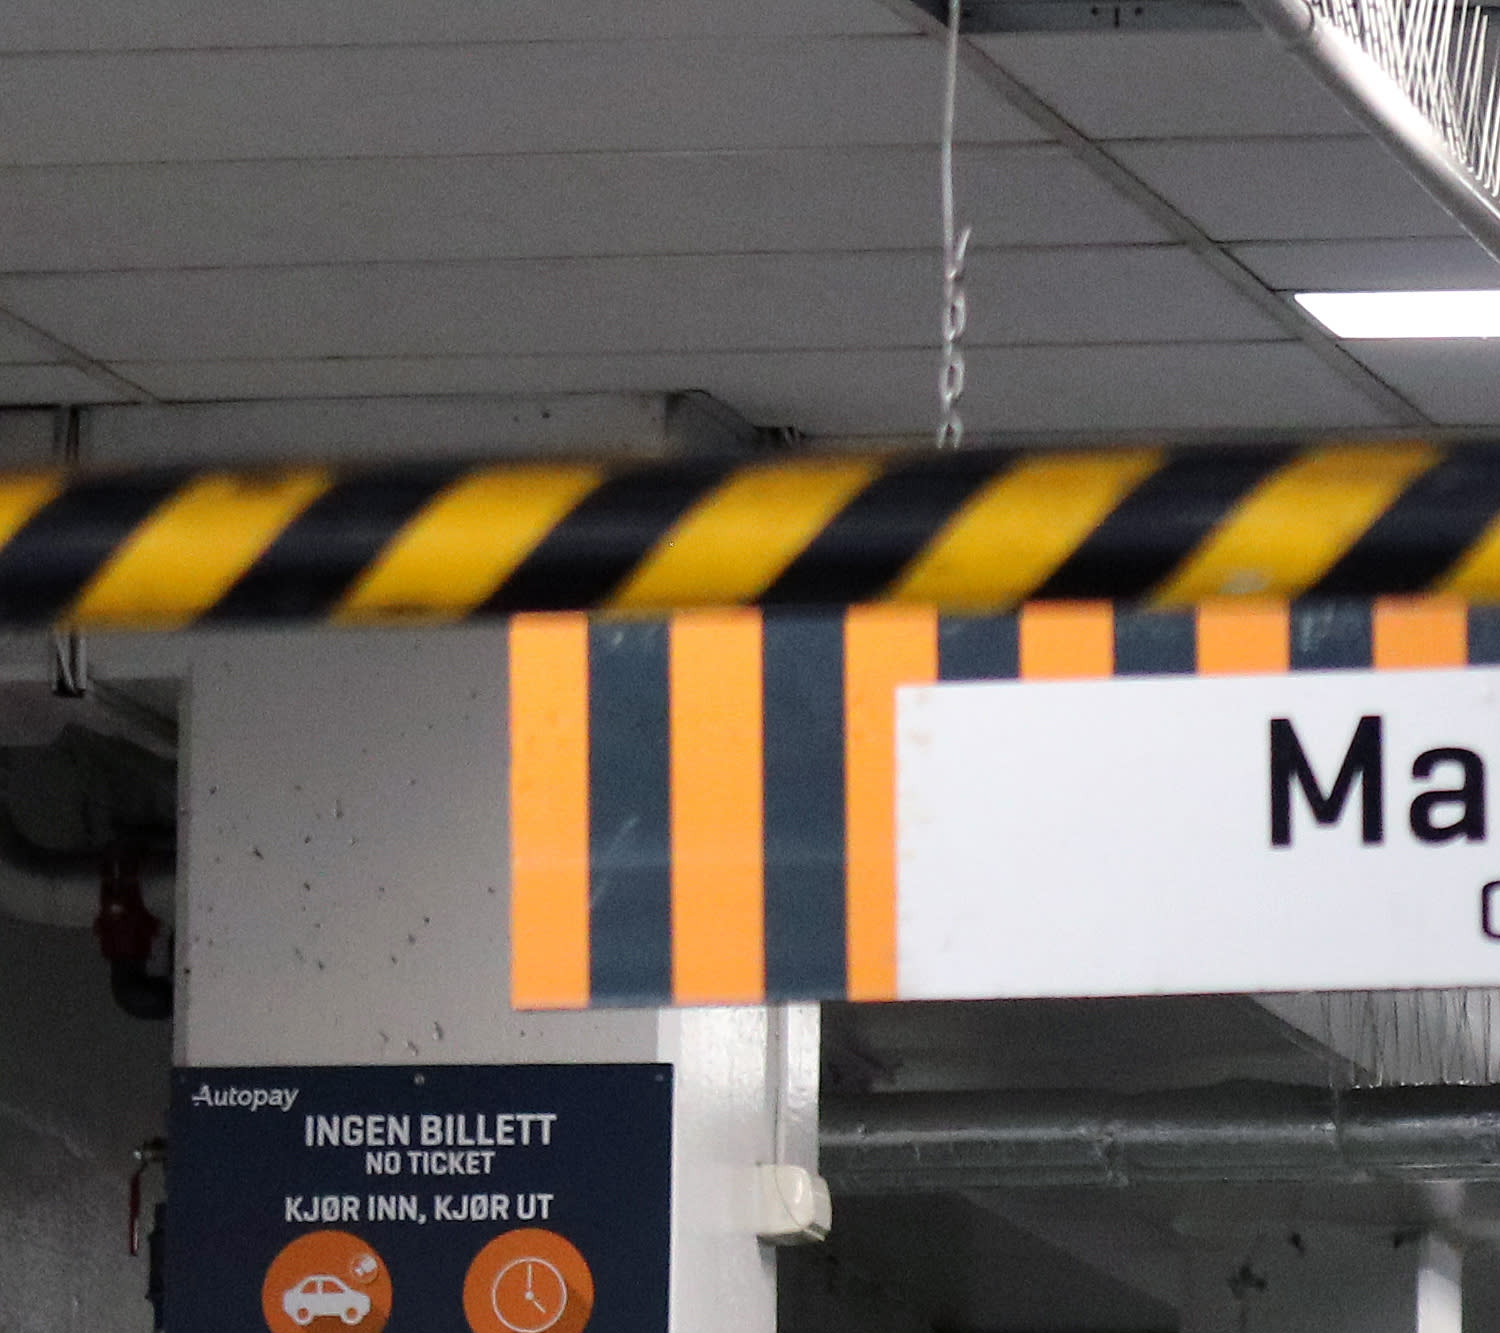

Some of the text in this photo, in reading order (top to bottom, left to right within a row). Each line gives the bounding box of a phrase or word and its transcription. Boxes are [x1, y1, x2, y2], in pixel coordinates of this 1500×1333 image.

[192, 1085, 299, 1112] Autopay
[305, 1112, 557, 1147] INGEN BILLETT
[365, 1151, 496, 1175] NO TICKET
[285, 1193, 554, 1225] KJØR INN, KJØR UT
